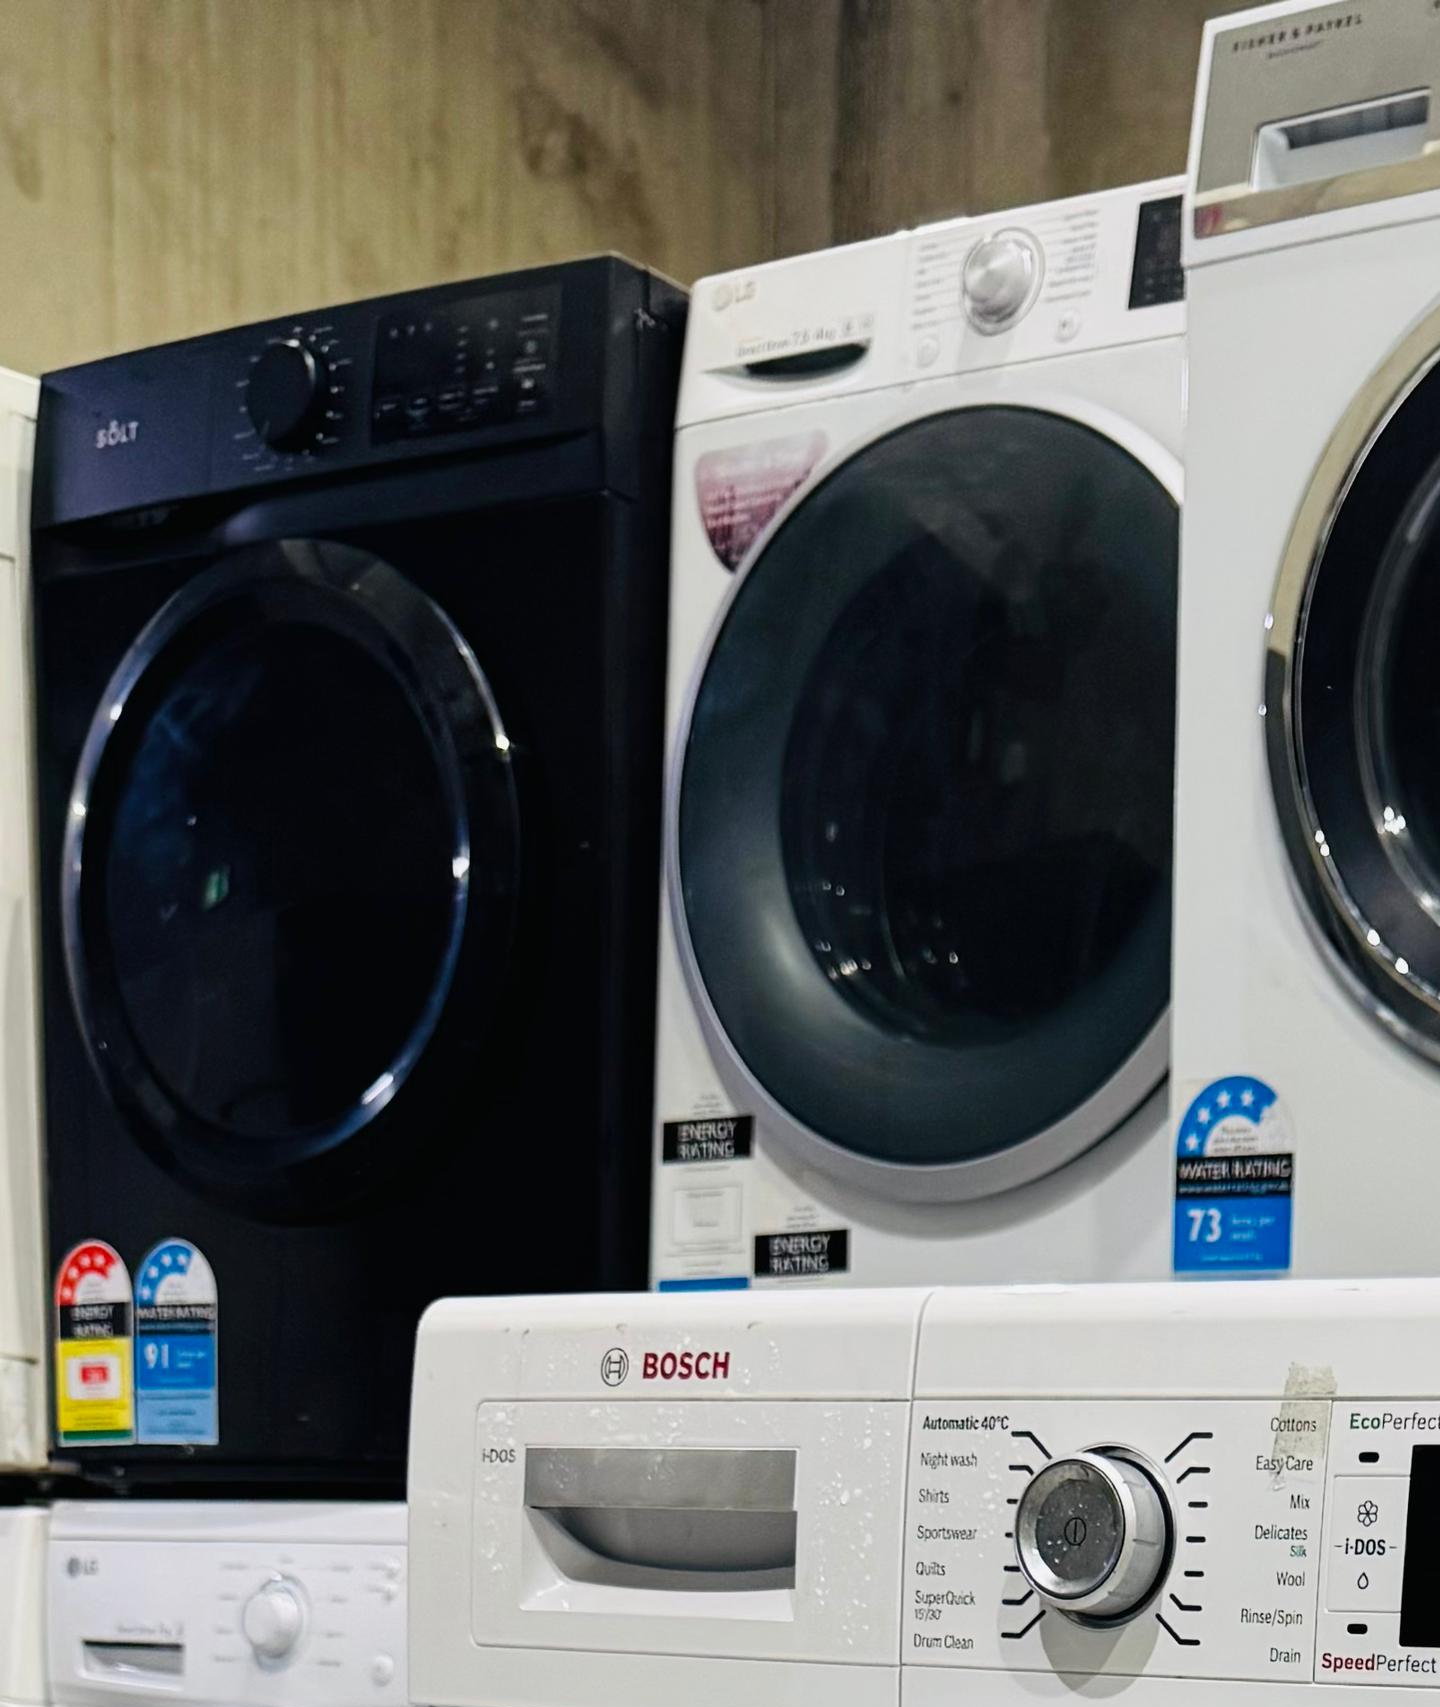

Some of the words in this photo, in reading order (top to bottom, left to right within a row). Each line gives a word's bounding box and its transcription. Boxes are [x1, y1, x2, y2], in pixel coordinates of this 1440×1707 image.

[678, 1120, 738, 1142] ENERGY
[679, 1140, 735, 1160] RATING
[1179, 1160, 1230, 1181] WATER
[1231, 1157, 1292, 1180] RATING
[1187, 1207, 1222, 1243] 73
[769, 1233, 831, 1257] ENERGY
[771, 1254, 829, 1275] RATING
[144, 1342, 169, 1369] 91
[642, 1351, 731, 1380] BOSCH
[922, 1415, 979, 1431] Automatic
[981, 1415, 1009, 1431] 40°C
[1270, 1417, 1317, 1433] Cottons
[920, 1452, 948, 1468] Night
[950, 1453, 978, 1467] wash
[1256, 1456, 1282, 1474] Easy
[1283, 1457, 1313, 1472] Care
[919, 1488, 949, 1504] Shirts
[1290, 1494, 1310, 1510] Mix
[917, 1526, 977, 1543] Sportswear
[1255, 1525, 1308, 1541] Delicates
[916, 1561, 946, 1578] Quilts
[1276, 1571, 1306, 1588] Wool
[915, 1591, 976, 1609] SuperQuick
[1240, 1608, 1303, 1627] Rinse/Spin
[914, 1634, 942, 1650] Drum
[943, 1635, 974, 1650] Clean
[1270, 1648, 1301, 1663] Drain
[1321, 1653, 1437, 1675] SpeedPerfect
